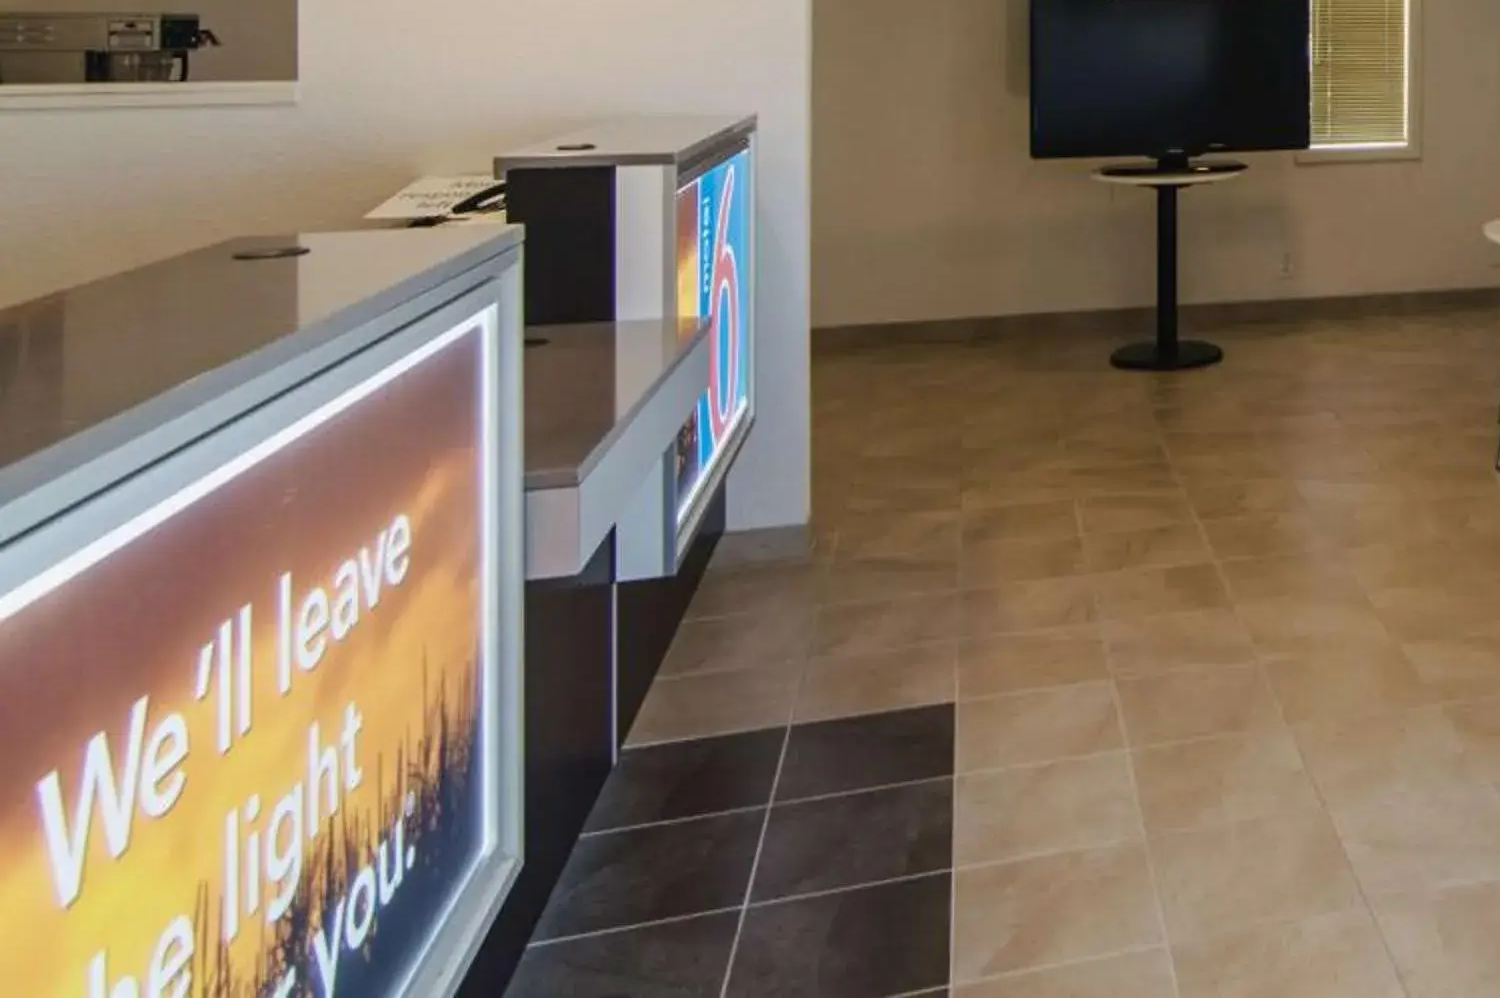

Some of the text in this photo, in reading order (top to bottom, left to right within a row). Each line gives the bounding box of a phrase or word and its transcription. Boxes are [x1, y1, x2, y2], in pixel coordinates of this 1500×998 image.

[708, 165, 738, 450] 6
[37, 513, 413, 910] We'll leave
[222, 699, 364, 938] light
